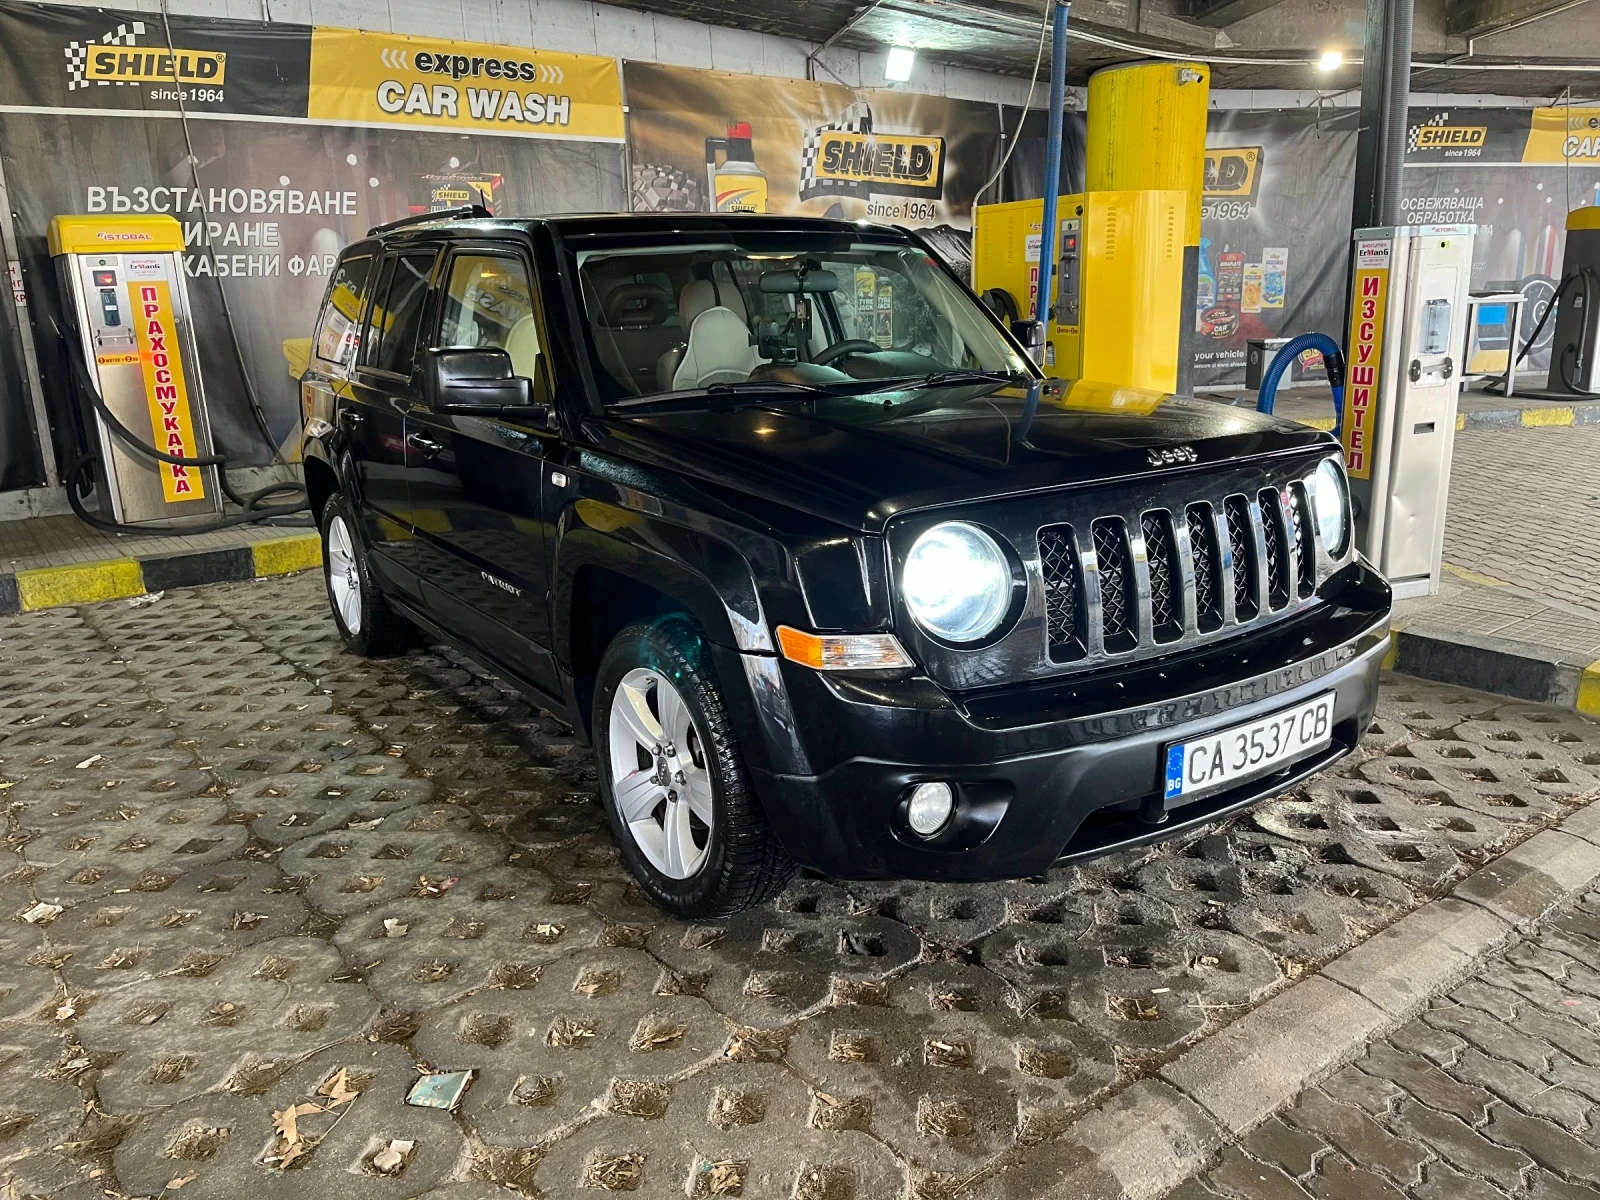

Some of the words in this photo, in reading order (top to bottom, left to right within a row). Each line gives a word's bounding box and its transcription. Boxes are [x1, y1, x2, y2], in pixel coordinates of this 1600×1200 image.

[414, 51, 536, 82] express
[150, 88, 188, 102] since
[190, 88, 225, 103] 1964
[377, 80, 459, 118] CAR
[466, 87, 571, 126] WASH
[1444, 149, 1463, 157] since
[1463, 148, 1482, 157] 1964
[87, 186, 358, 216] ВЪЗСТАНОВЯВАНЕ
[438, 191, 468, 199] SHIELD
[1401, 196, 1484, 212] ОСВЕЖЯВАЩА
[867, 200, 900, 219] since
[902, 201, 936, 222] 1964
[1406, 210, 1475, 225] ОБРАБОТКА
[181, 221, 279, 248] ИРАНЕ
[1194, 351, 1214, 361] your
[1215, 349, 1245, 359] vehicle
[1346, 275, 1380, 471] ИЗСУШИТЕЛ
[1146, 445, 1198, 467] Jeep
[1188, 740, 1225, 785] CA
[1232, 714, 1296, 771] 3537
[1299, 702, 1328, 745] CB
[1168, 776, 1182, 791] BG
